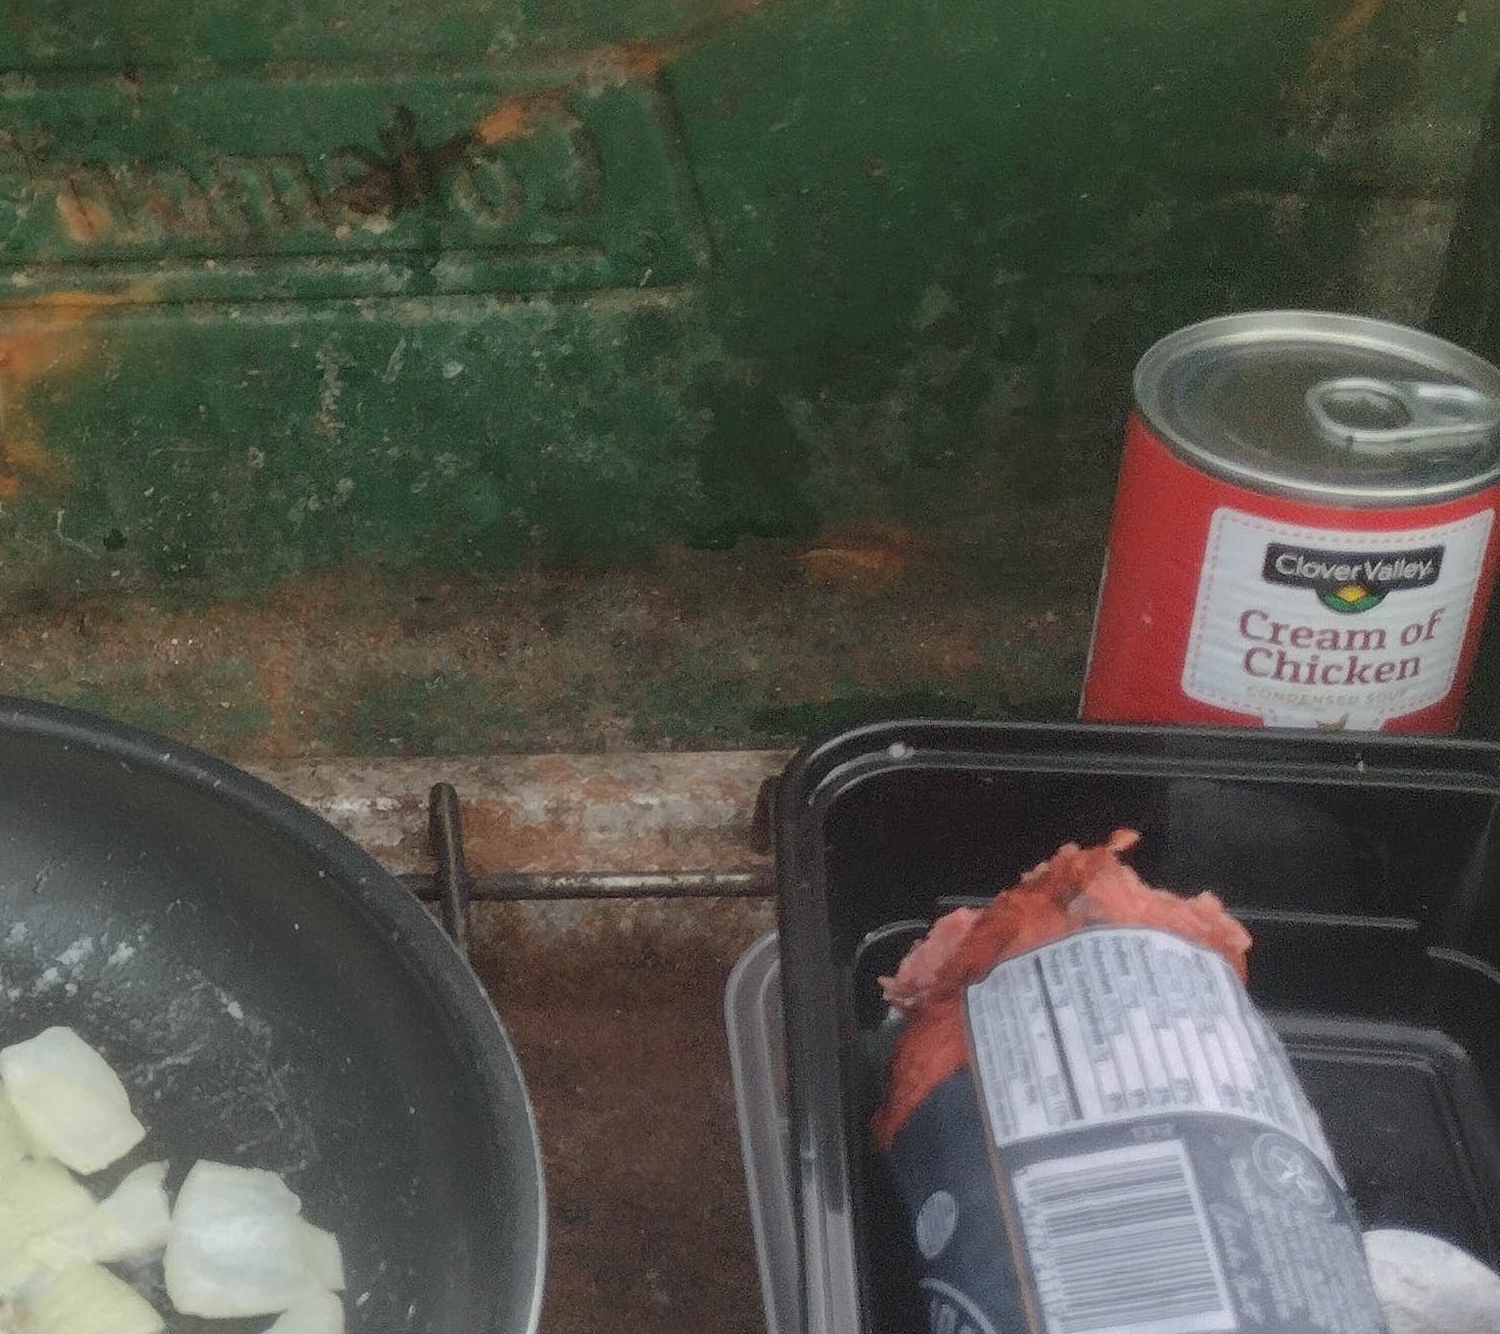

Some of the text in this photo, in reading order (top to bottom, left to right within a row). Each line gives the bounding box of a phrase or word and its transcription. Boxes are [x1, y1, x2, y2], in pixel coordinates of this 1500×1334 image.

[1275, 552, 1435, 581] Clover Valley
[1239, 606, 1446, 652] Cream of
[1243, 646, 1421, 686] Chicken
